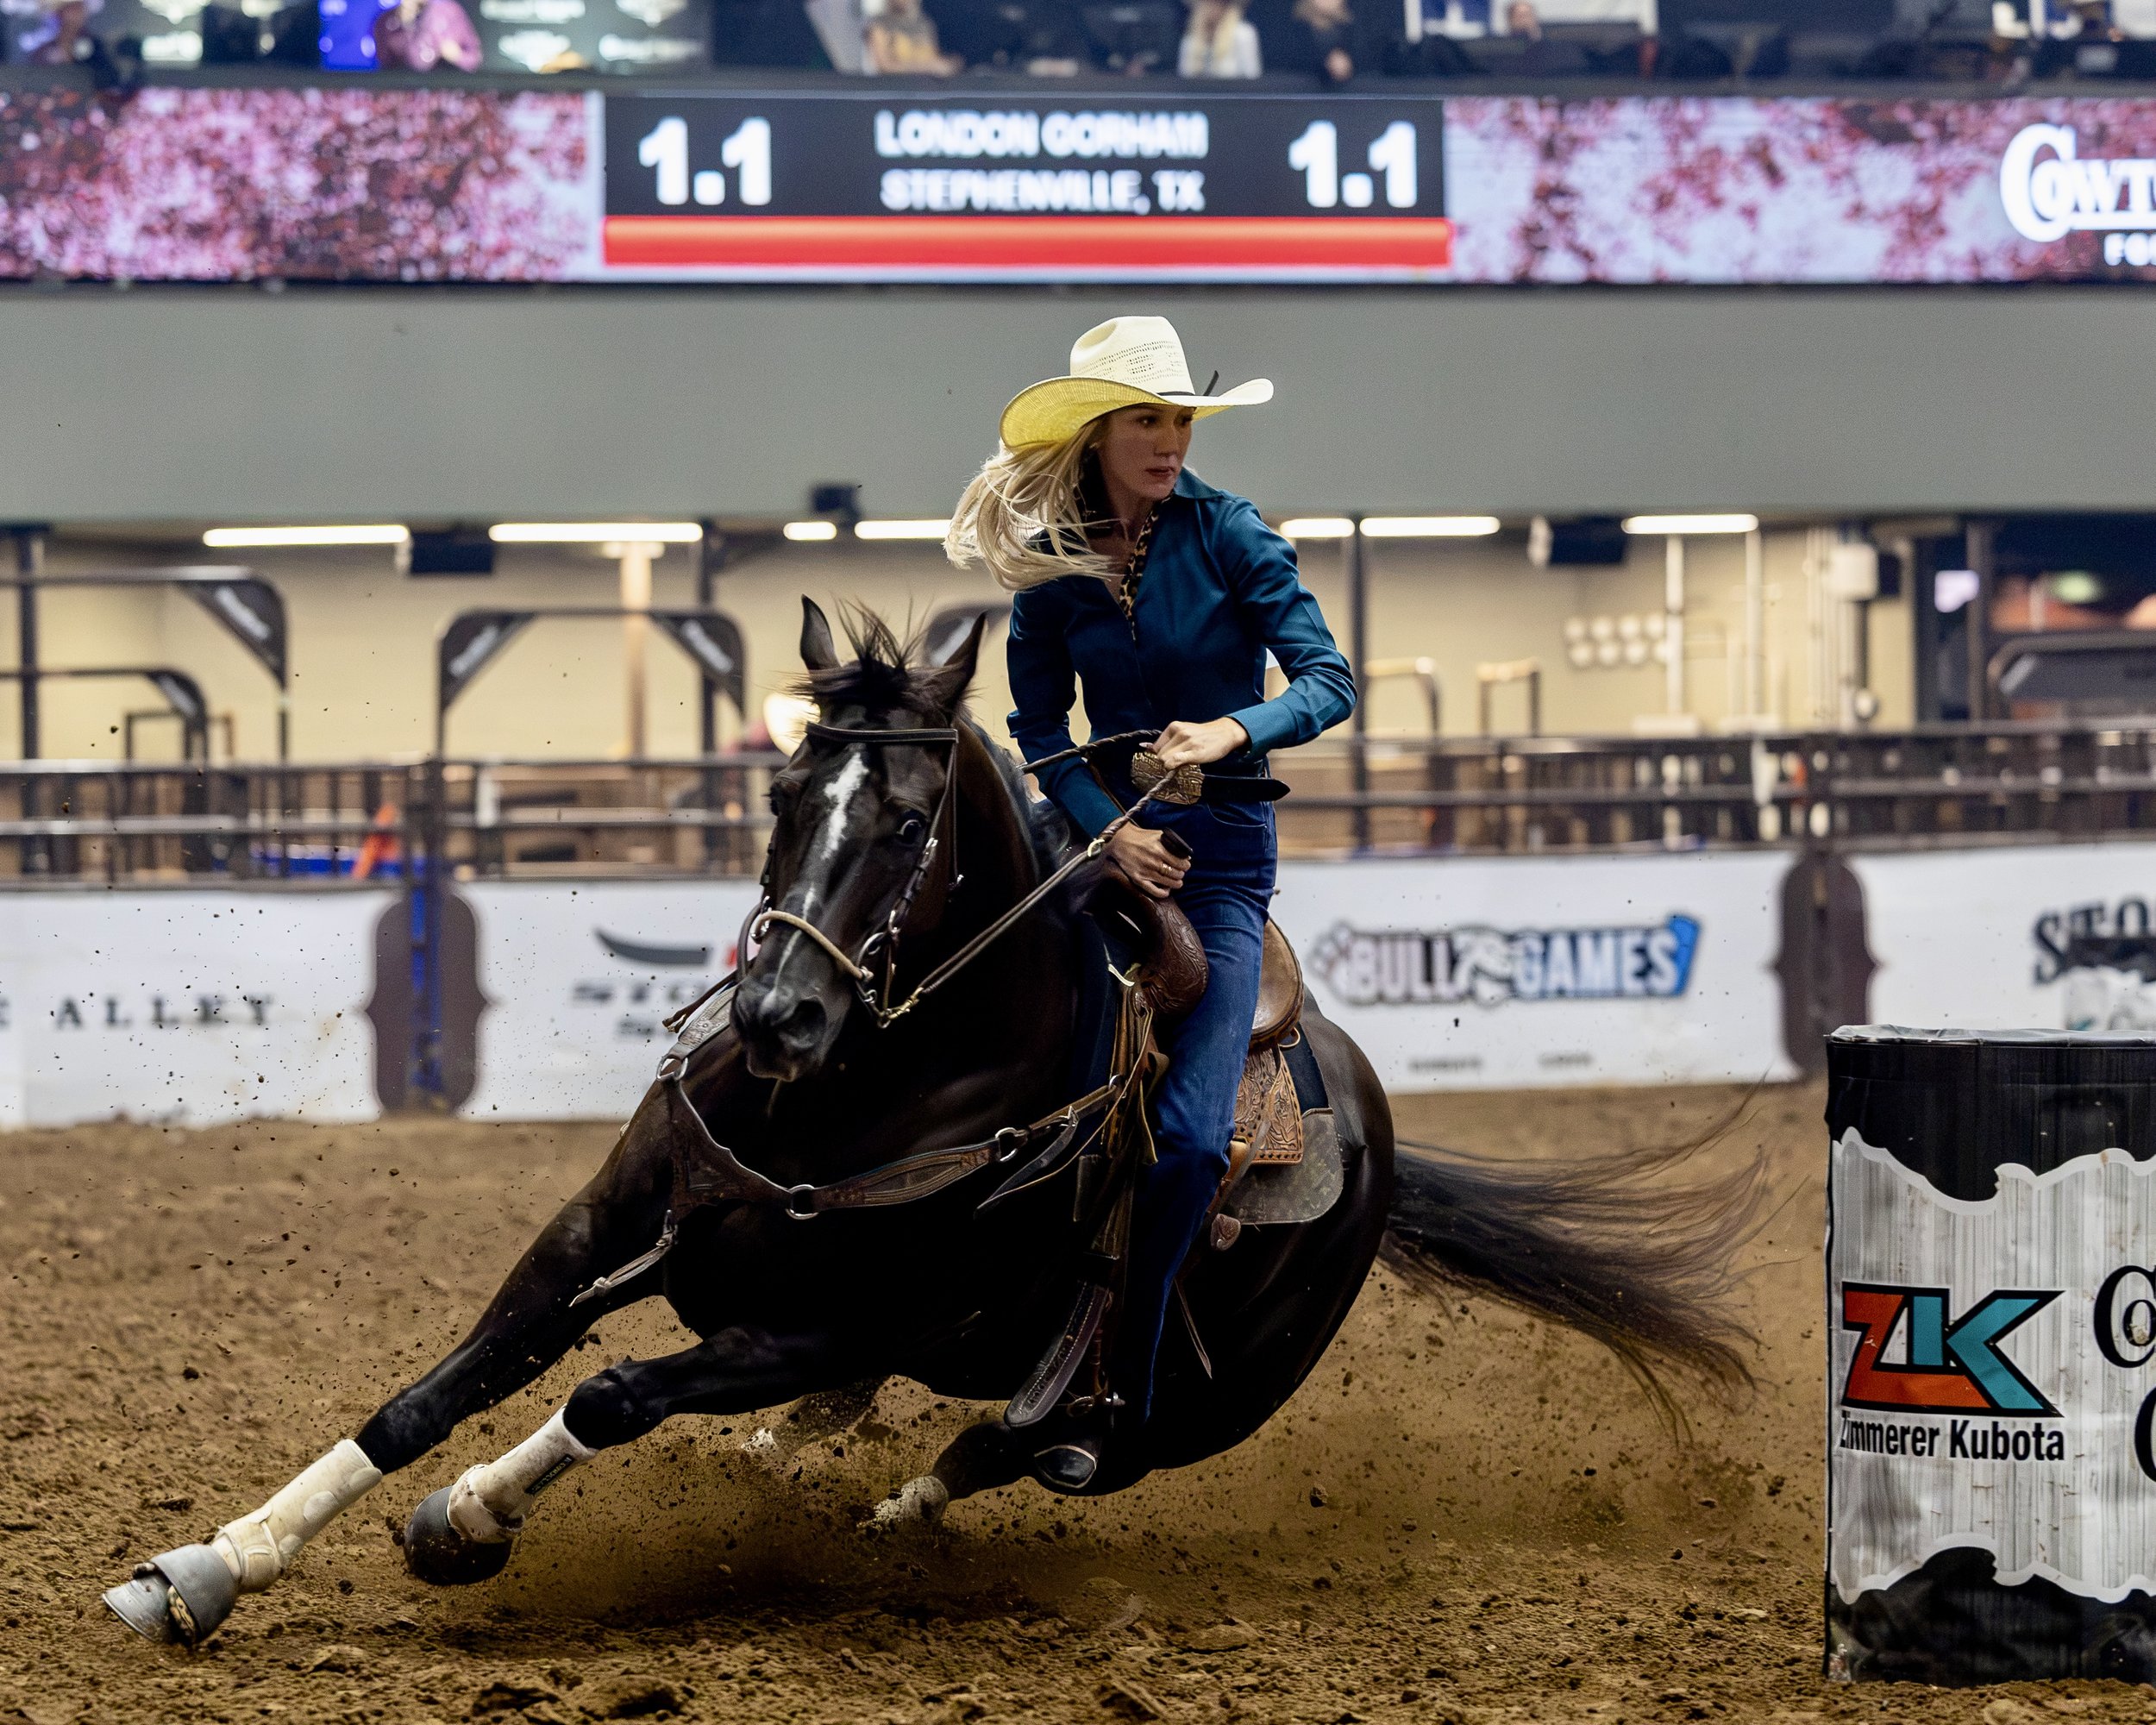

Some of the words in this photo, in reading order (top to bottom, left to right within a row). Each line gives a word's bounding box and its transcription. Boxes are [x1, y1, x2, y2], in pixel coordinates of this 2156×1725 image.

[874, 110, 1040, 157] LONDON
[638, 115, 772, 205] 1.1
[1288, 119, 1417, 208] 1.1
[2000, 123, 2156, 242] COWT
[1153, 170, 1205, 211] TX
[55, 994, 276, 1030] ALLEY
[1950, 1420, 2065, 1460] Kubota
